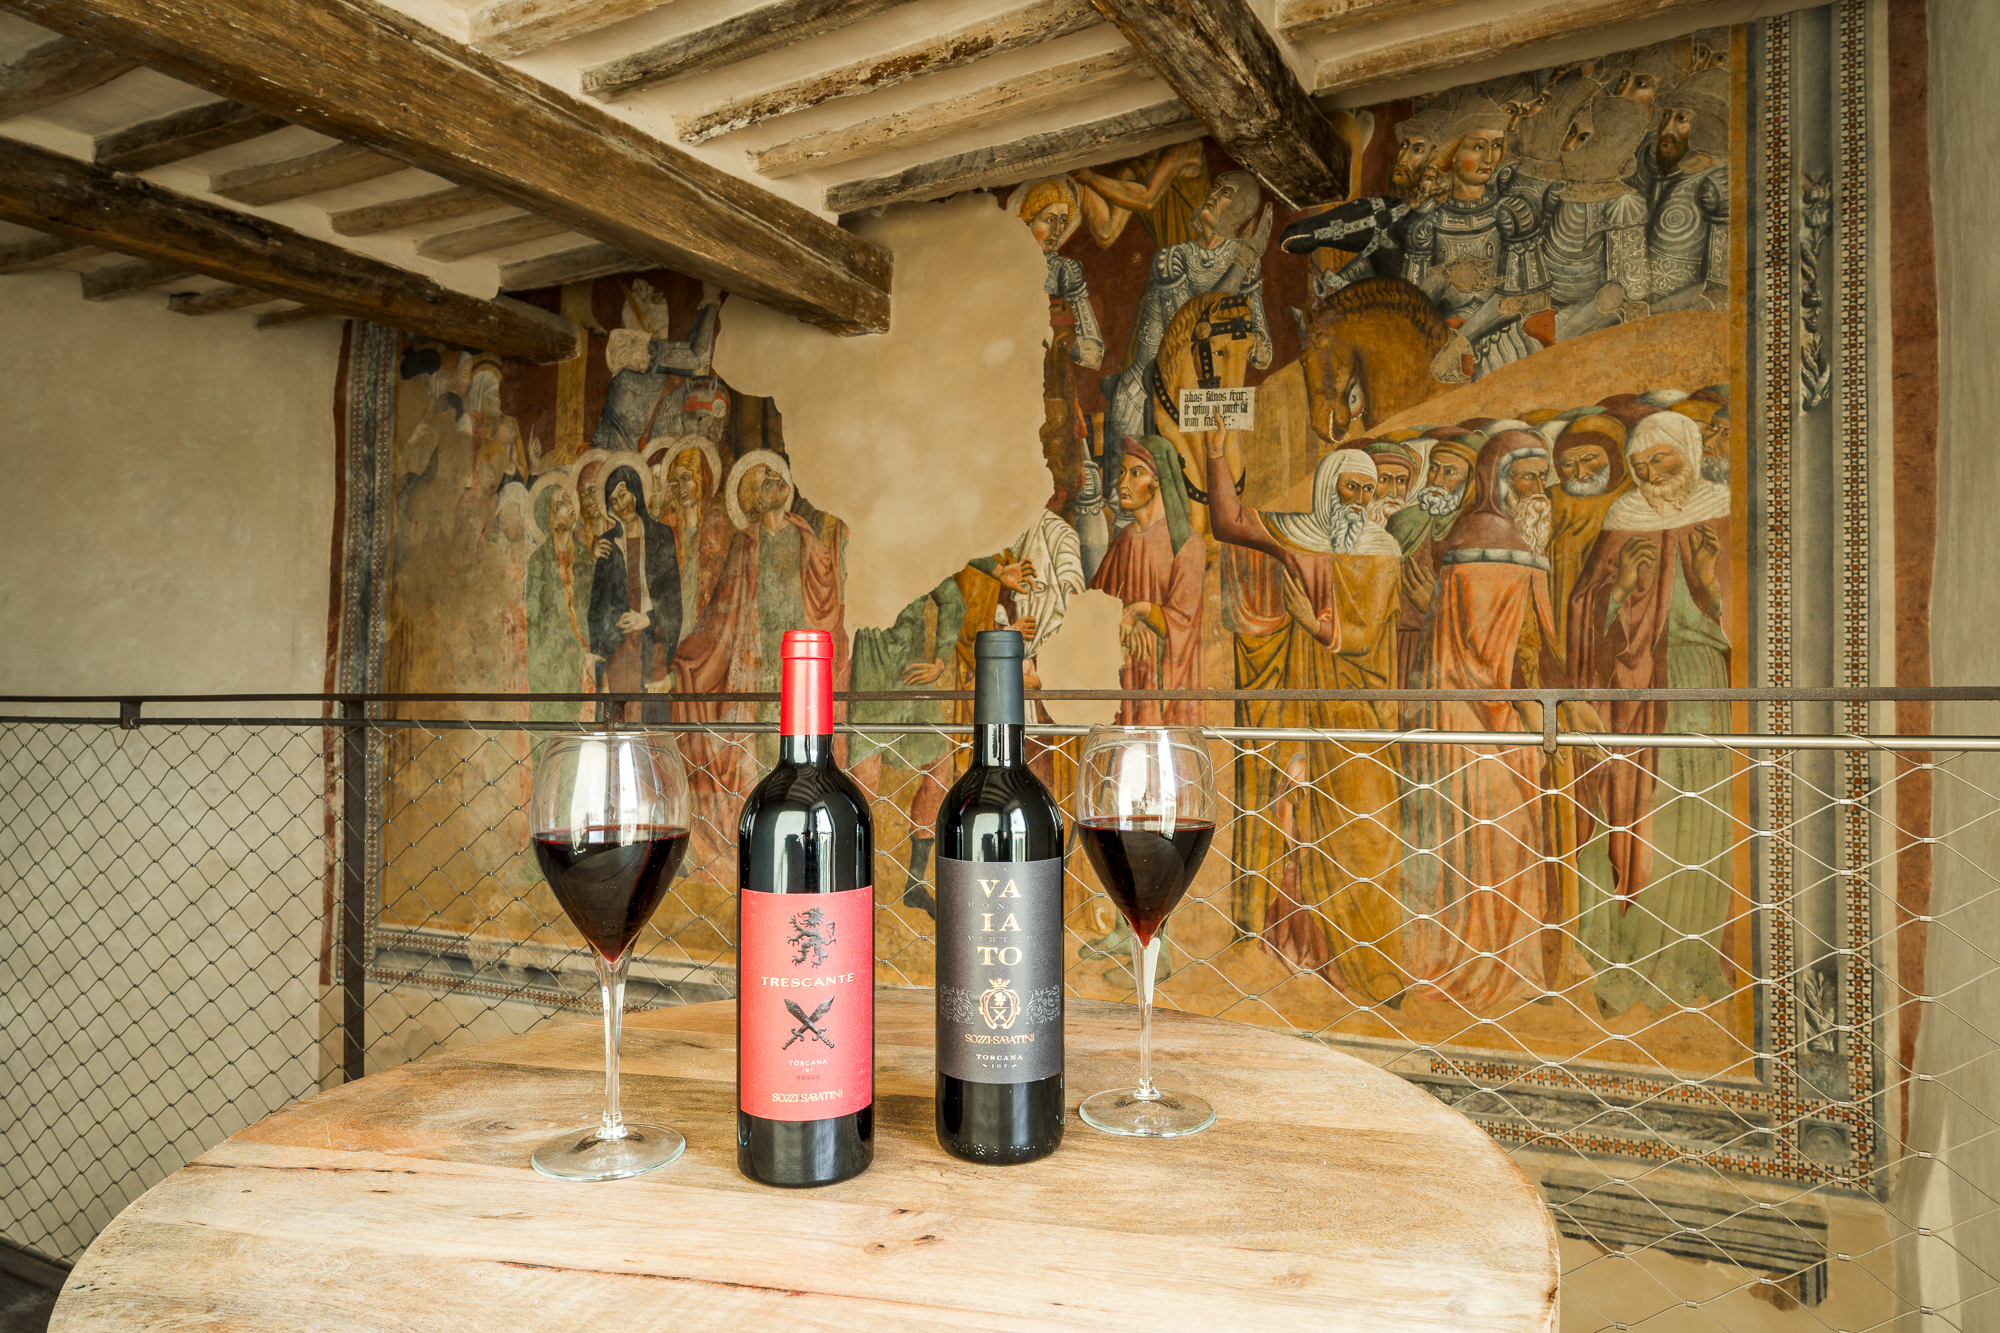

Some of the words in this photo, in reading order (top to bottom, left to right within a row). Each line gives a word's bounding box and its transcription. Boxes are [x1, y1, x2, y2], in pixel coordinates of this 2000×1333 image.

[977, 878, 1022, 898] VA
[980, 912, 1023, 932] IA
[977, 946, 1023, 966] TO
[760, 972, 855, 988] TRESCANTE
[789, 1059, 828, 1067] TOSCANA
[975, 1053, 1023, 1061] TOSCANA
